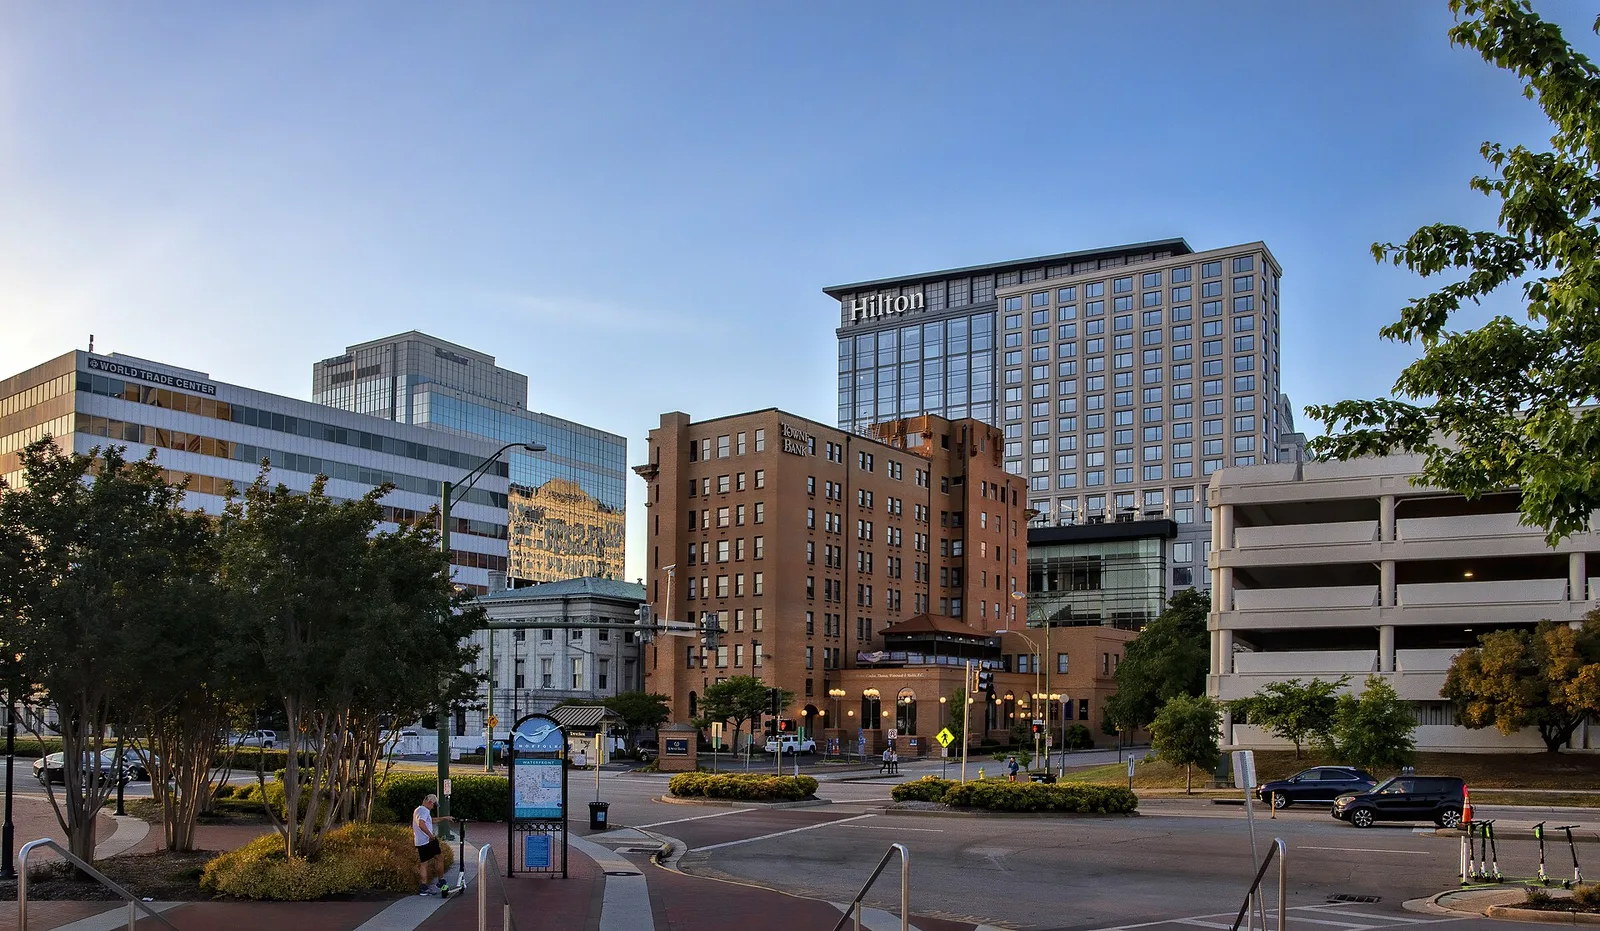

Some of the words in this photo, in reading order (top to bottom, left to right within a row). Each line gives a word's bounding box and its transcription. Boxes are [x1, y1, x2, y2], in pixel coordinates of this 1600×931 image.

[851, 292, 925, 321] Hilton
[99, 361, 138, 377] WORLD
[140, 370, 174, 385] TRADE
[175, 379, 215, 395] CENTER
[784, 438, 808, 457] BANK
